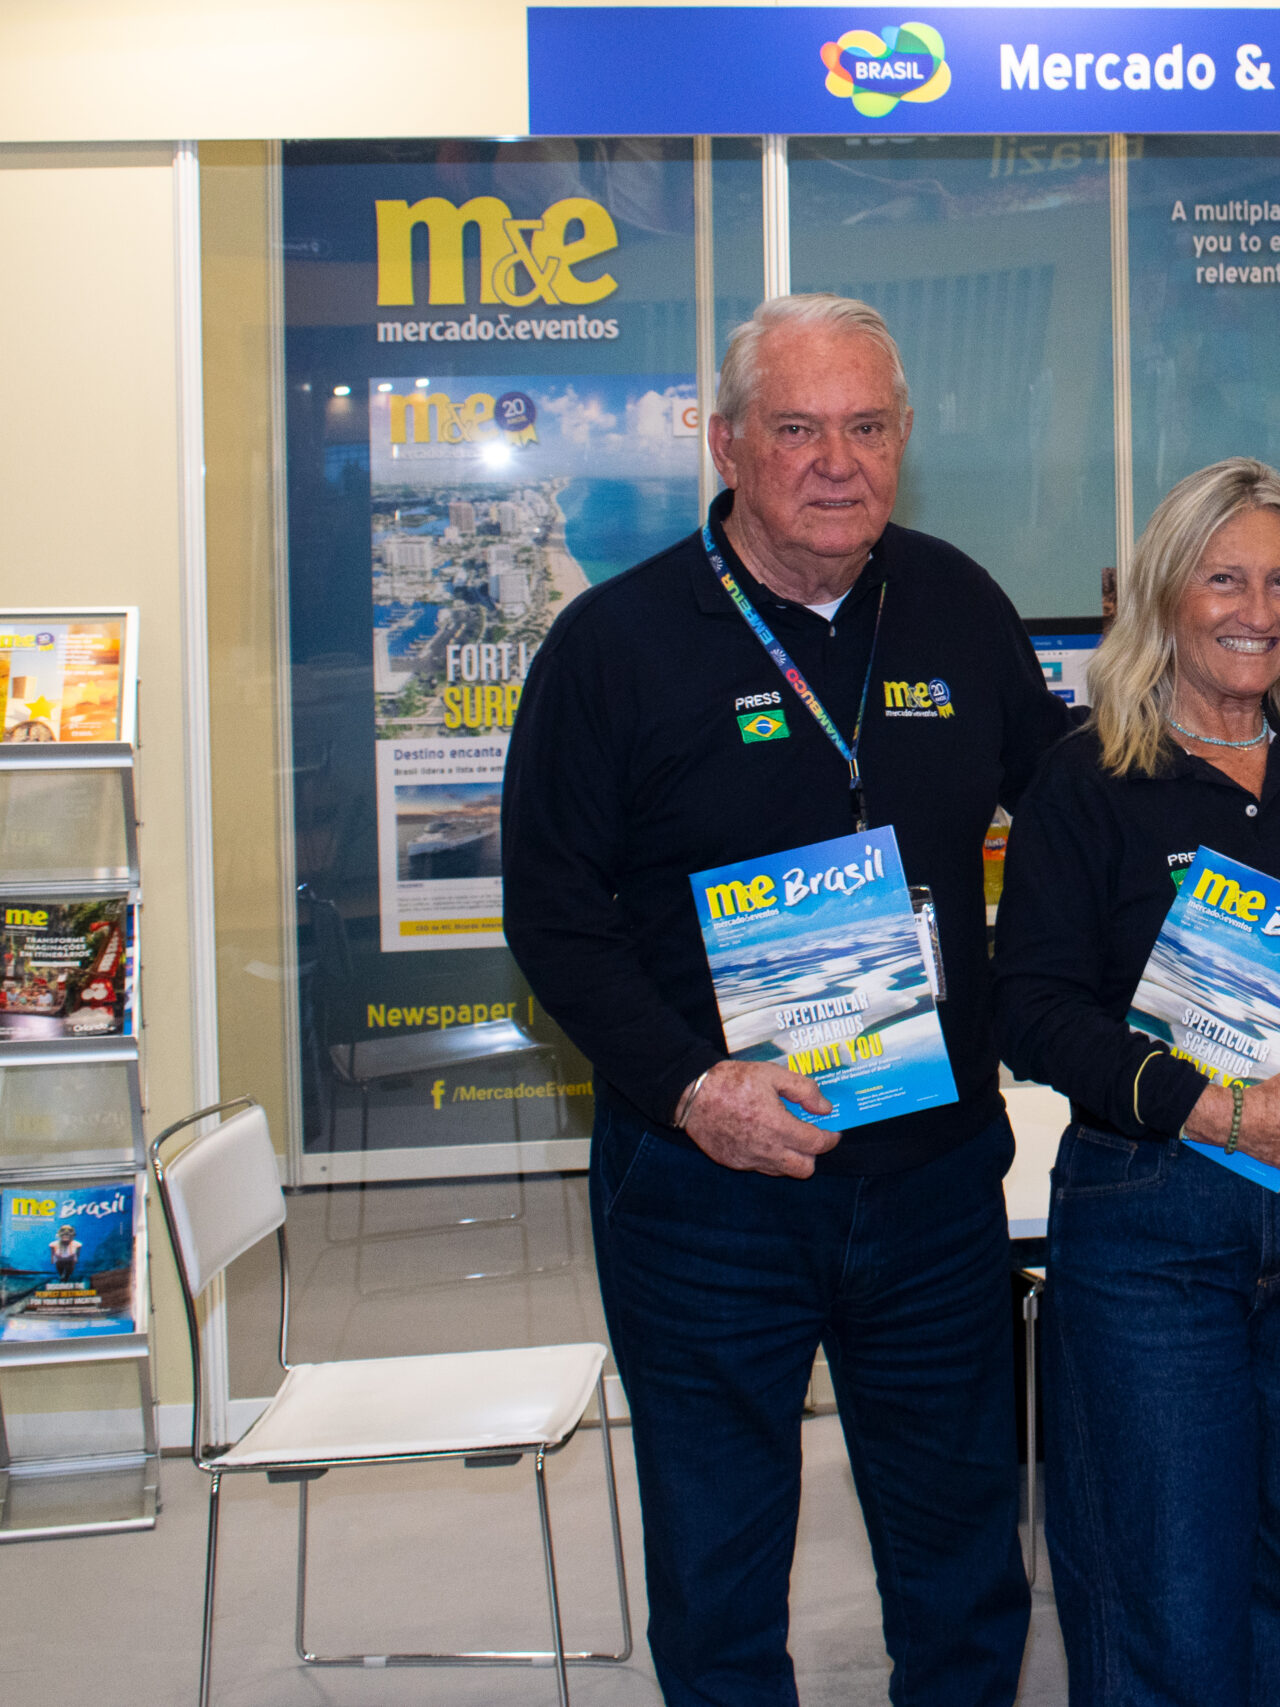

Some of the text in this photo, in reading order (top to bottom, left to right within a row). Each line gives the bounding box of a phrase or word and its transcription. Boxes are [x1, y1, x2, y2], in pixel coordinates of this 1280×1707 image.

[855, 60, 925, 80] BRASIL
[999, 43, 1217, 91] Mercado
[1234, 44, 1275, 91] &
[1171, 200, 1187, 222] A
[375, 196, 618, 307] m&e
[1193, 235, 1232, 258] you
[1239, 232, 1262, 252] to
[377, 313, 620, 343] mercado&eventos
[502, 398, 526, 418] 20
[721, 573, 775, 645] EMPETUR
[446, 643, 513, 681] FORT
[734, 692, 782, 711] PRESS
[931, 683, 945, 697] 20
[394, 747, 502, 760] Destino encanta
[1167, 851, 1197, 867] PRE
[783, 845, 884, 907] Brasil
[1187, 899, 1253, 933] mercado&eventos
[367, 1001, 517, 1029] Newspaper
[776, 992, 871, 1031] SPECTACULAR
[789, 1014, 865, 1050] SCENARIOS
[1181, 1008, 1270, 1062] SPECTACULAR
[787, 1032, 884, 1076] AWAIT YOU
[1182, 1031, 1254, 1078] SCENARIOS
[59, 1192, 126, 1219] Brasil
